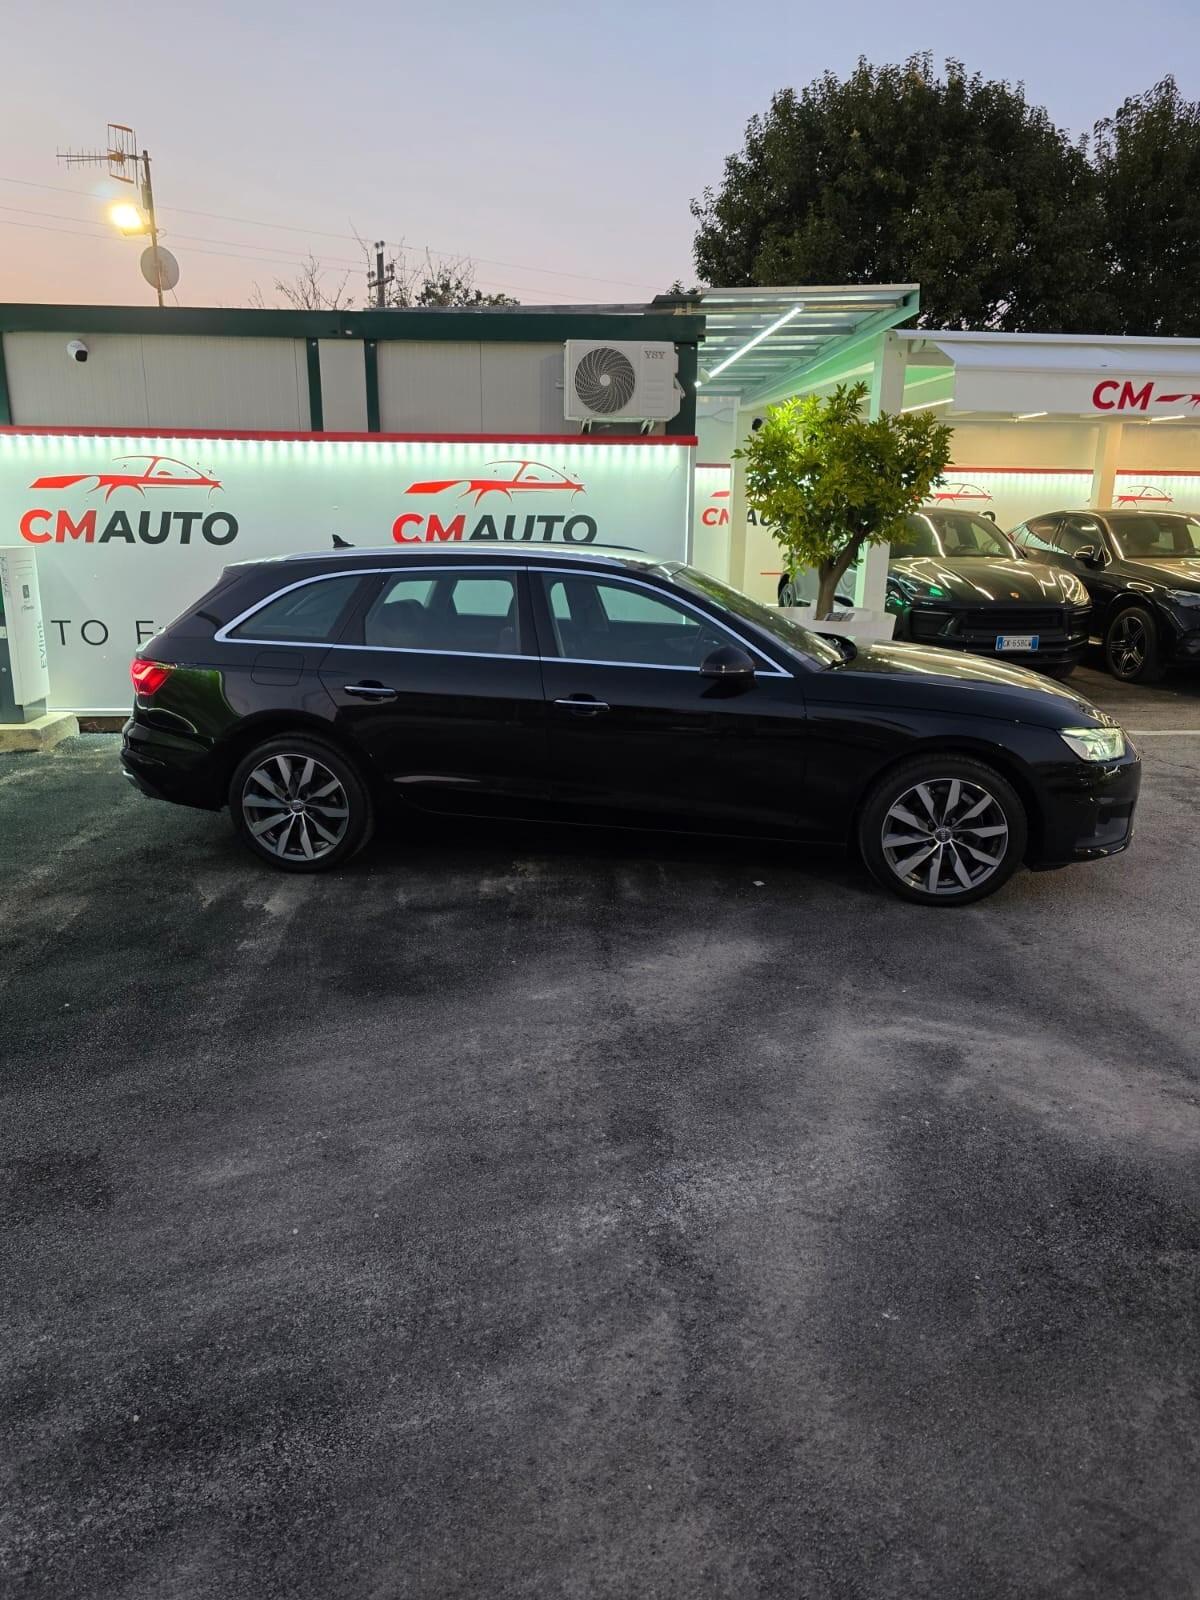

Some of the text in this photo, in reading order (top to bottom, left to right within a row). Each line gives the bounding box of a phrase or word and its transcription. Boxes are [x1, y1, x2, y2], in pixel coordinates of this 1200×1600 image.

[1092, 380, 1155, 410] CM
[19, 508, 239, 545] CMAUTO
[392, 512, 598, 544] CMAUTO
